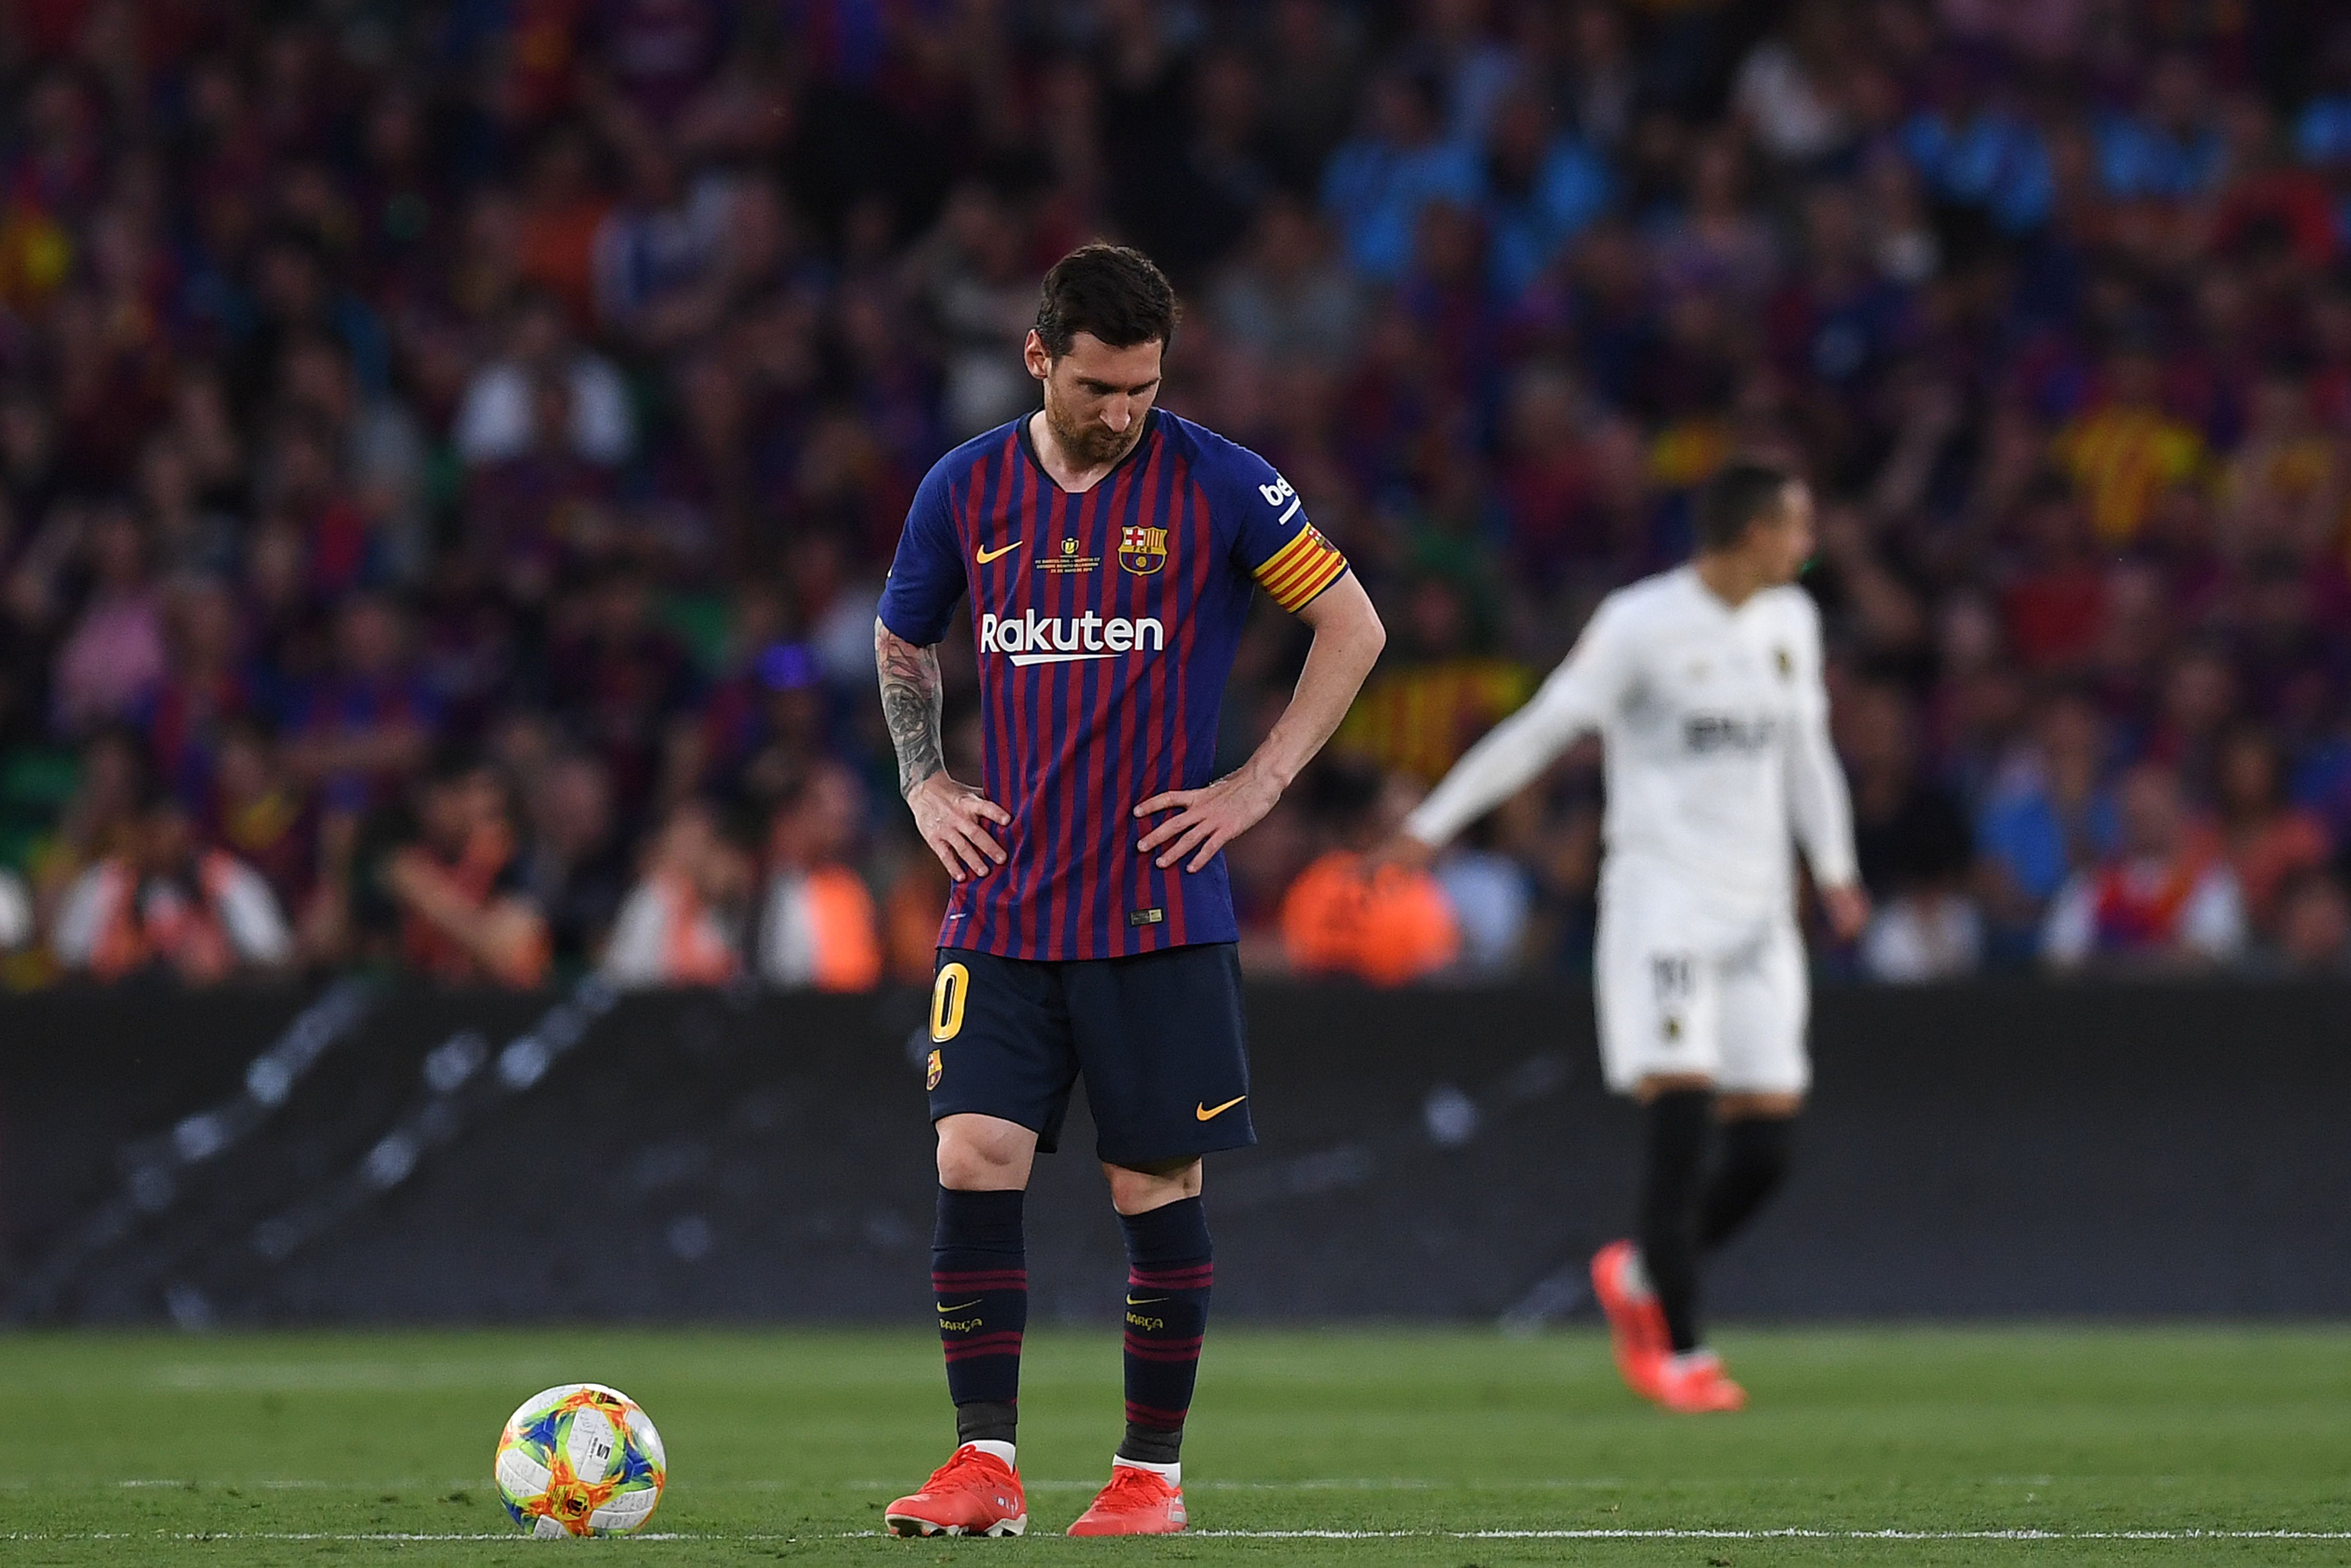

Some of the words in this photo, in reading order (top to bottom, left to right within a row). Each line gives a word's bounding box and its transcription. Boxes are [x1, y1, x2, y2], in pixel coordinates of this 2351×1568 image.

[1259, 472, 1296, 506] be
[981, 609, 1163, 653] Rakuten
[929, 962, 969, 1043] 0
[939, 1318, 982, 1332] BARÇA
[1126, 1312, 1163, 1331] BARÇA
